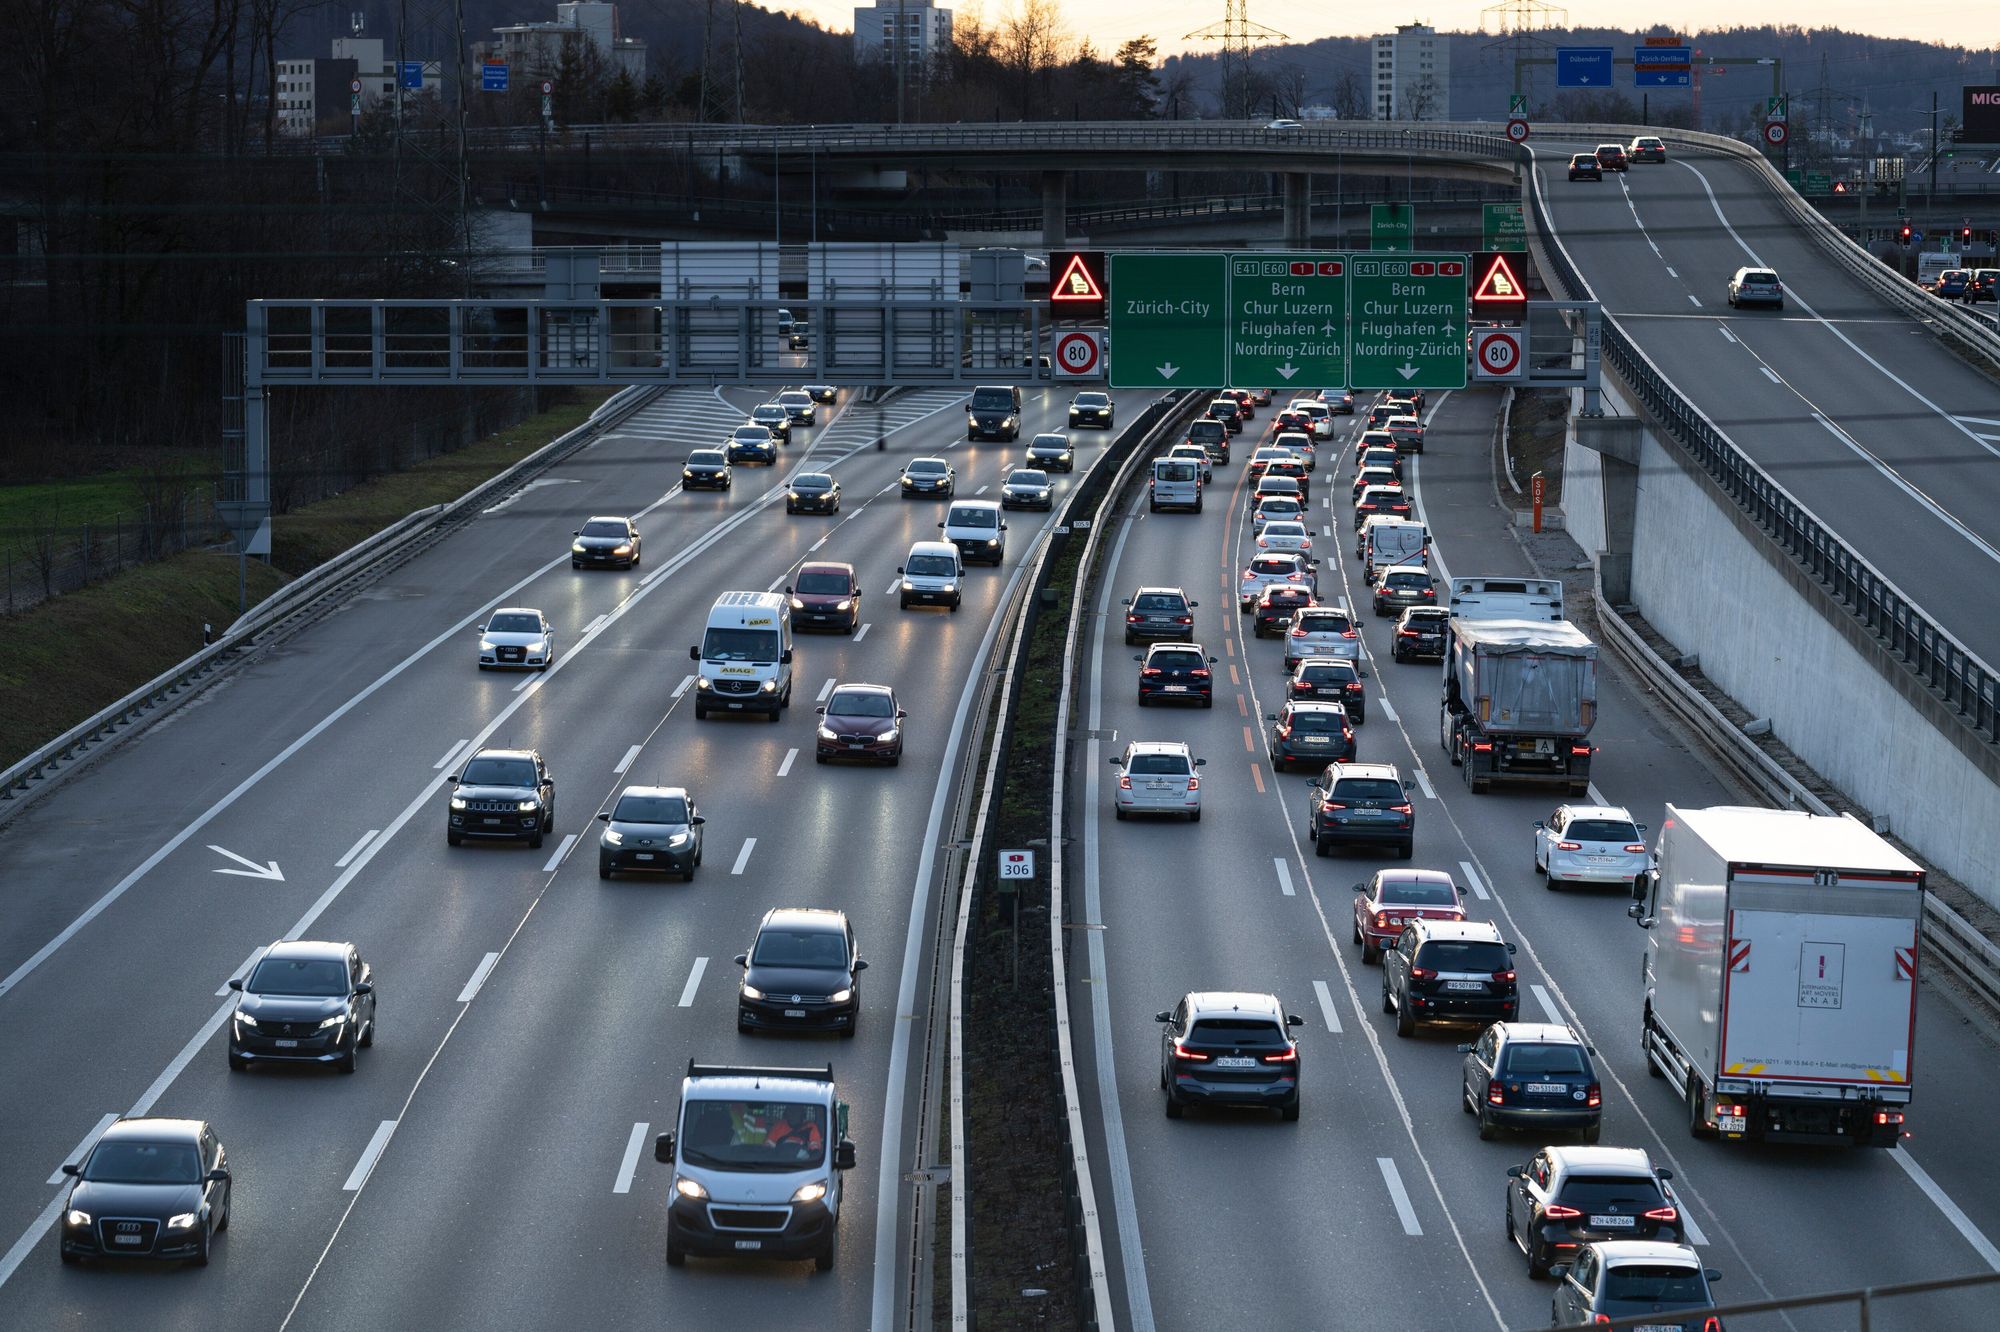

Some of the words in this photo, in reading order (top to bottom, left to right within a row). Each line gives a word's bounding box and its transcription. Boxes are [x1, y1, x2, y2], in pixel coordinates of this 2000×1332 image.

[1641, 55, 1684, 63] Zürich-Oerlikon
[1513, 126, 1523, 135] 80
[1772, 129, 1782, 138] 80
[1377, 222, 1407, 230] Zürich-City
[1237, 265, 1256, 274] E41
[1264, 265, 1284, 274] E60
[1300, 265, 1304, 274] 1
[1328, 265, 1333, 274] 4
[1357, 265, 1376, 274] E41
[1385, 265, 1404, 274] E60
[1420, 265, 1425, 274] 1
[1448, 265, 1453, 274] 4
[1272, 282, 1305, 296] Bern
[1392, 282, 1425, 296] Bern
[1127, 300, 1210, 318] Zürich-City
[1244, 301, 1278, 314] Chur
[1284, 301, 1332, 314] Luzern
[1364, 301, 1399, 314] Chur
[1405, 301, 1453, 314] Luzern
[1241, 321, 1315, 338] Flughafen
[1362, 321, 1435, 338] Flughafen
[1069, 346, 1086, 360] 80
[1235, 342, 1340, 359] Nordring-Zürich
[1356, 342, 1461, 359] Nordring-Zürich
[1490, 347, 1507, 361] 80
[1541, 740, 1549, 751] A
[1005, 864, 1029, 875] 306
[1596, 1216, 1604, 1224] ZH
[1606, 1217, 1630, 1225] 498266
